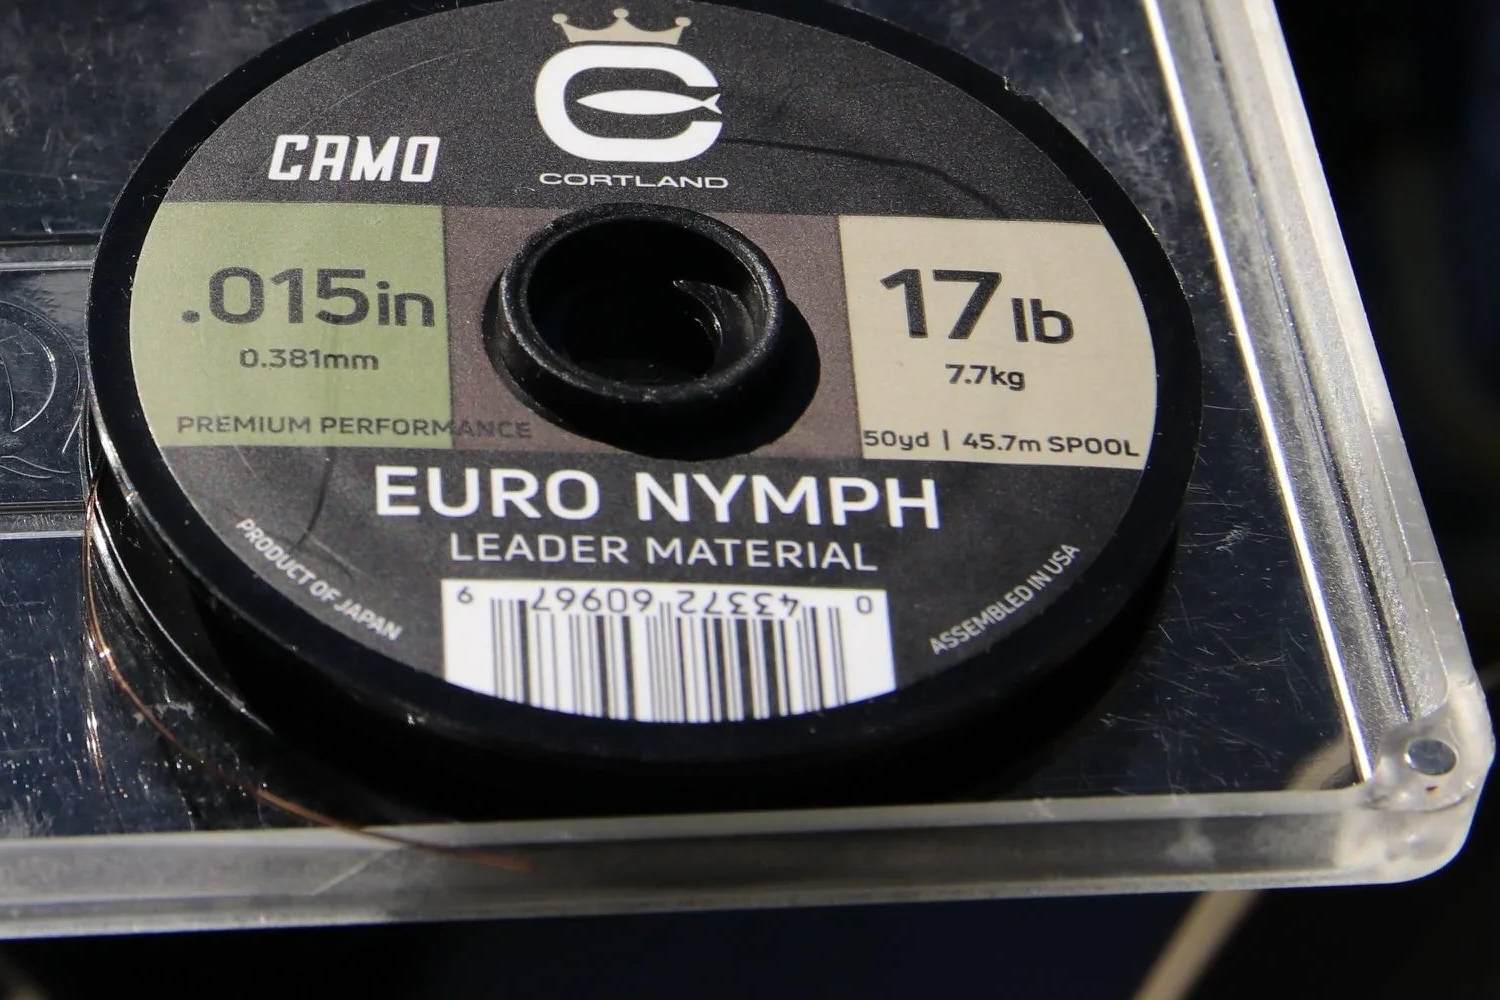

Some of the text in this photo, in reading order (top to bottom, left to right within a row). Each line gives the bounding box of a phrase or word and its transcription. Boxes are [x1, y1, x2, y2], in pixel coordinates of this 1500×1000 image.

[267, 134, 441, 183] CAMO
[539, 172, 729, 190] CORTLAND
[181, 266, 435, 328] .015in
[239, 348, 379, 370] 0.381mm
[945, 364, 1026, 391] 7.7kg
[177, 415, 533, 439] PREMIUM PERFORMANCE
[863, 430, 930, 450] 50yd
[962, 432, 1042, 453] 45.7m
[1048, 436, 1141, 457] SPOOL
[375, 466, 940, 530] EURO NYMPH
[450, 533, 878, 572] LEADER MATERIAL
[236, 518, 403, 642] PRODUCT OF JAPAN
[677, 590, 799, 617] 43372
[929, 544, 1080, 655] ASSEMBLED IN USA
